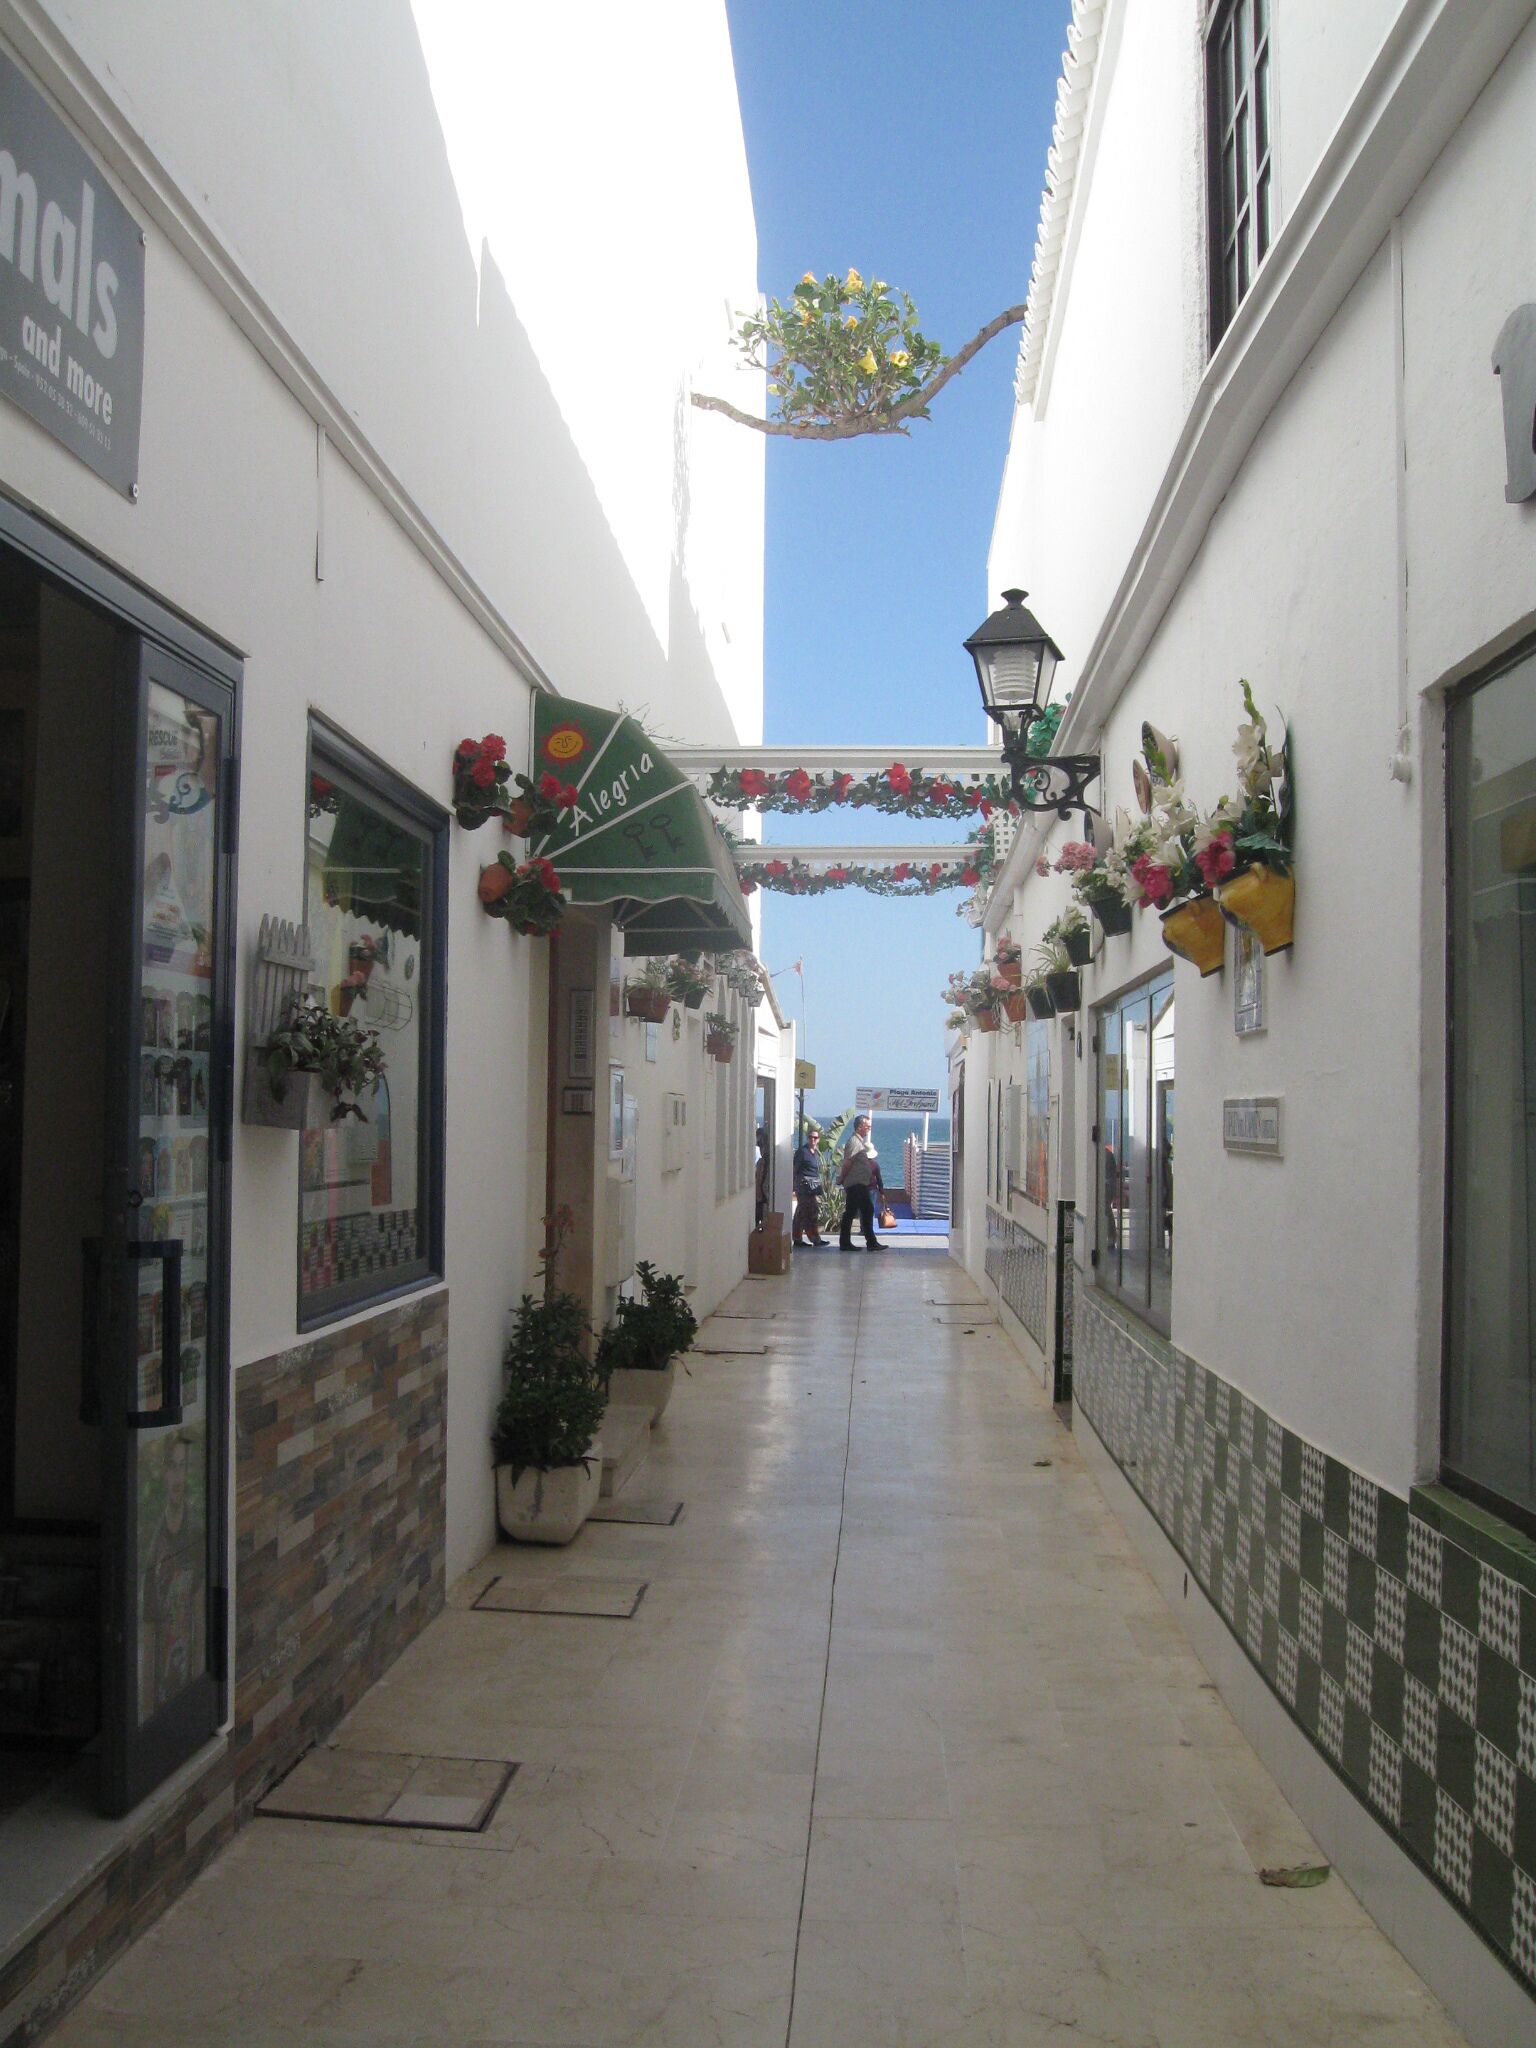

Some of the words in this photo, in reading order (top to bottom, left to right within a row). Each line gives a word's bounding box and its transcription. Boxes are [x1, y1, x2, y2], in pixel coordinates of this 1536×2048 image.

[22, 315, 61, 378] and
[66, 355, 113, 425] more
[569, 753, 655, 837] Alegria
